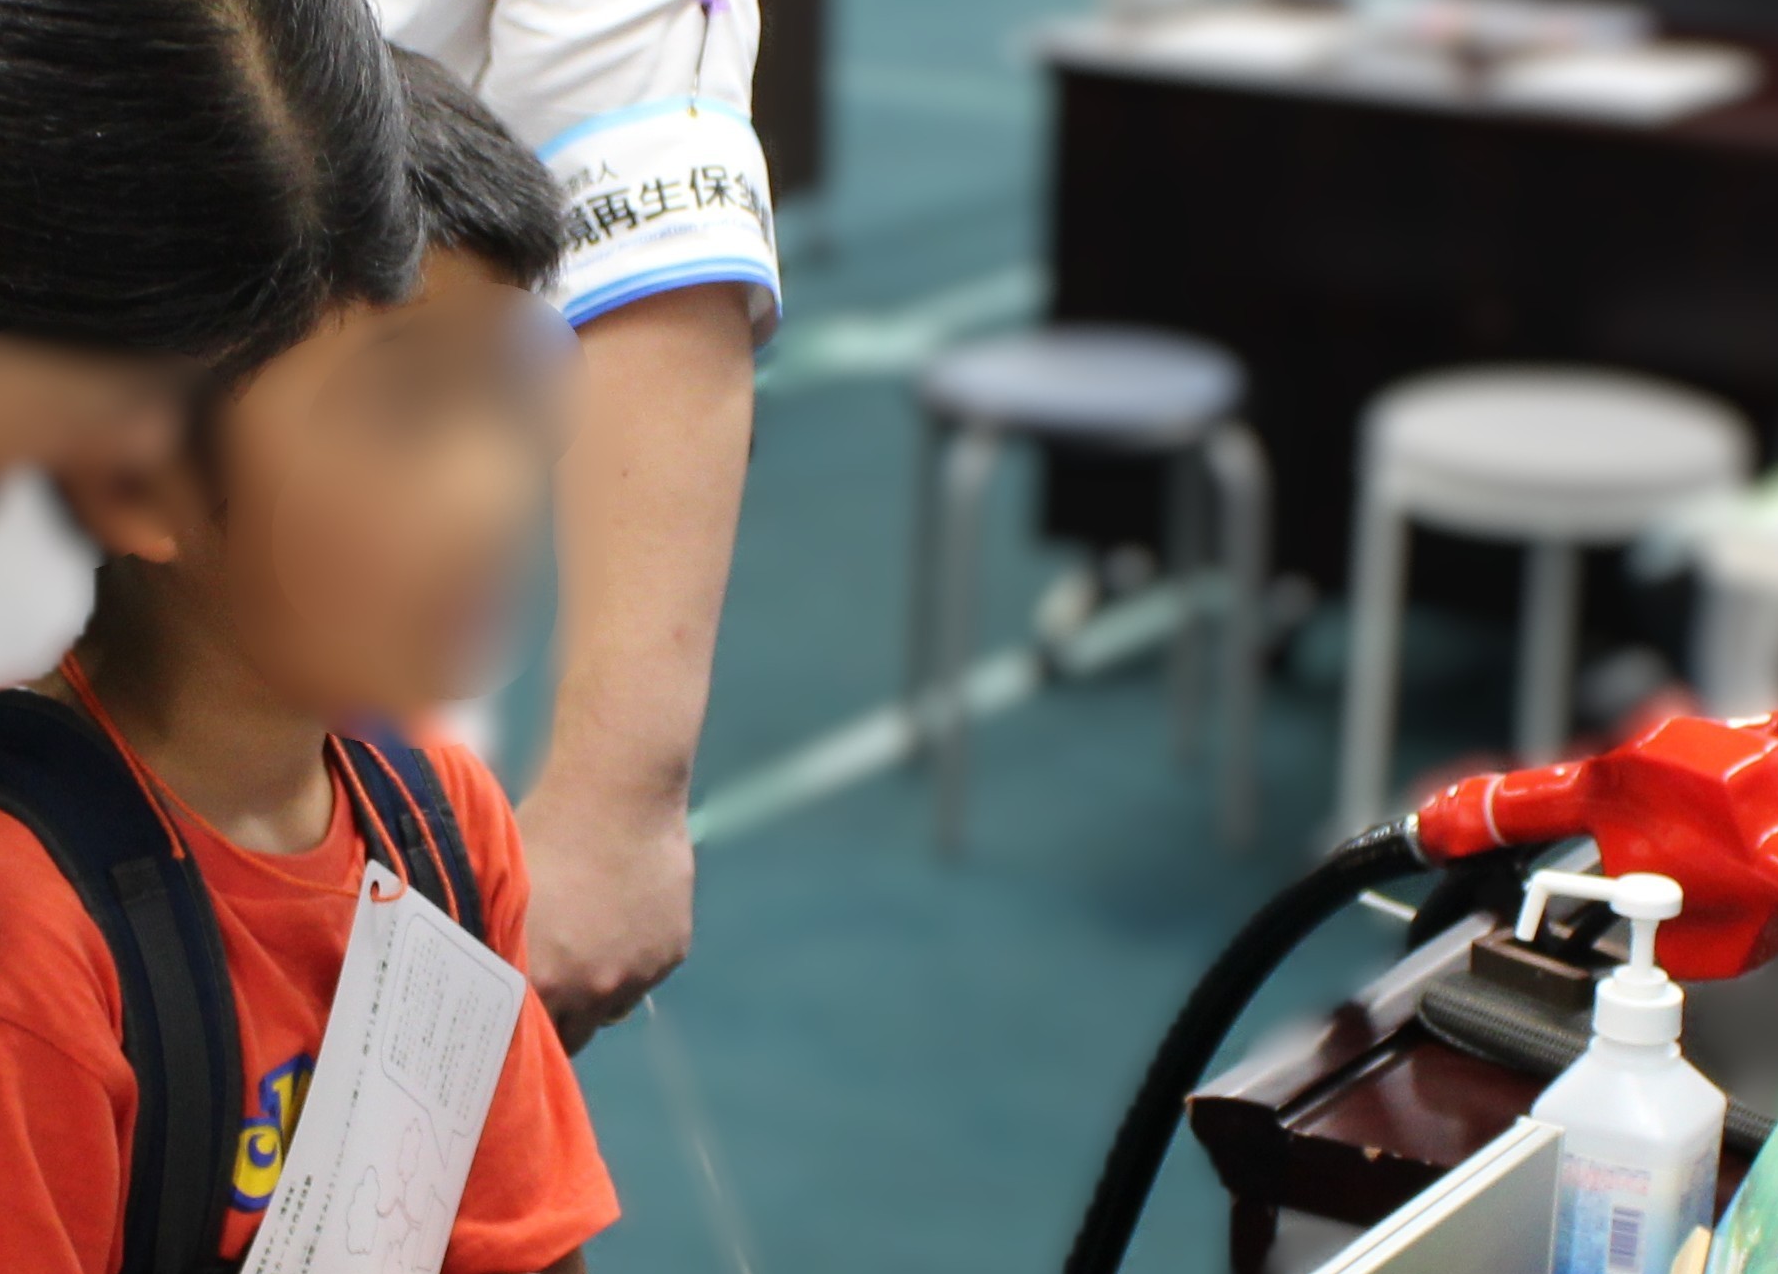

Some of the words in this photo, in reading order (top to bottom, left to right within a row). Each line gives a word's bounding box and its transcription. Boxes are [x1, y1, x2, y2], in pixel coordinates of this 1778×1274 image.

[564, 164, 773, 252] 境再生保全
